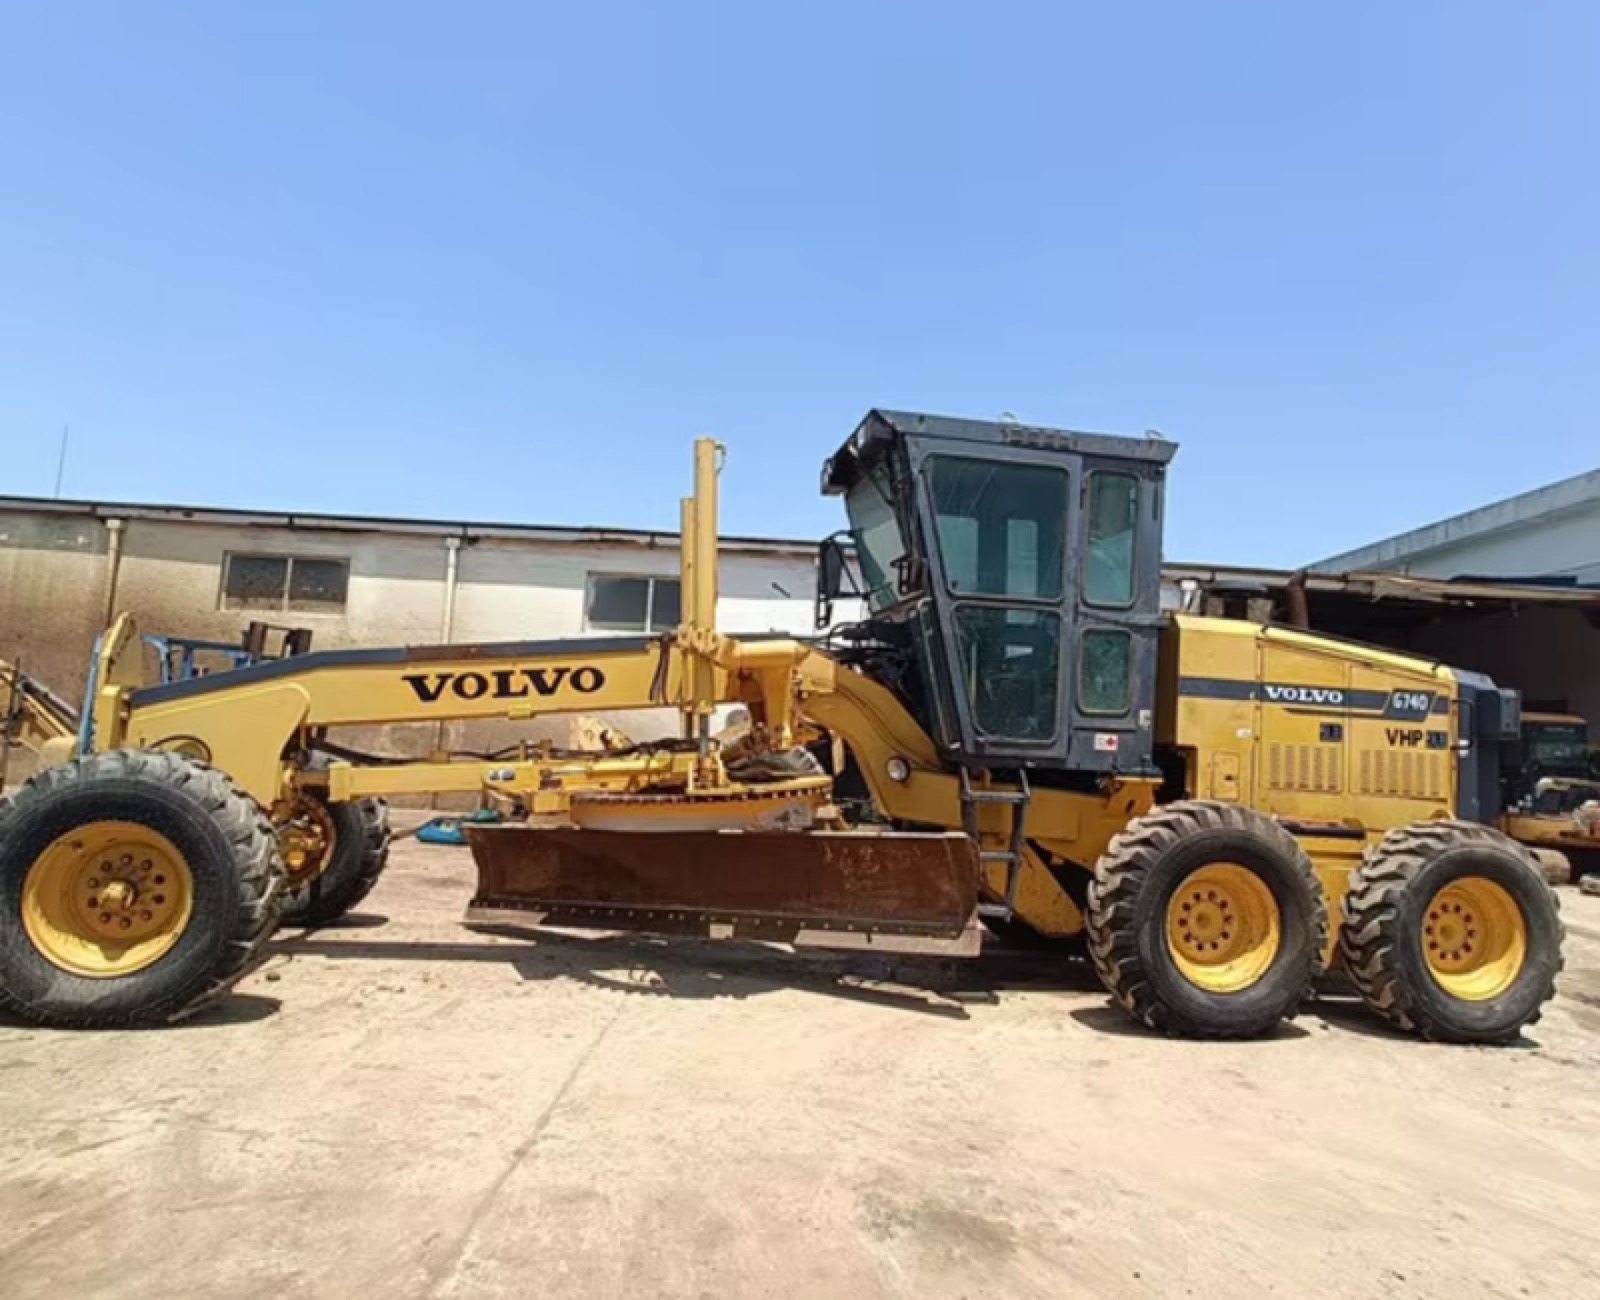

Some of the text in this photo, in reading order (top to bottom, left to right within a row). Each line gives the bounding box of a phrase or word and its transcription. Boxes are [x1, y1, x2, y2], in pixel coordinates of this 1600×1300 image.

[402, 667, 605, 702] VOLVO
[1264, 686, 1343, 703] VOLVO
[1385, 729, 1423, 747] VHP
